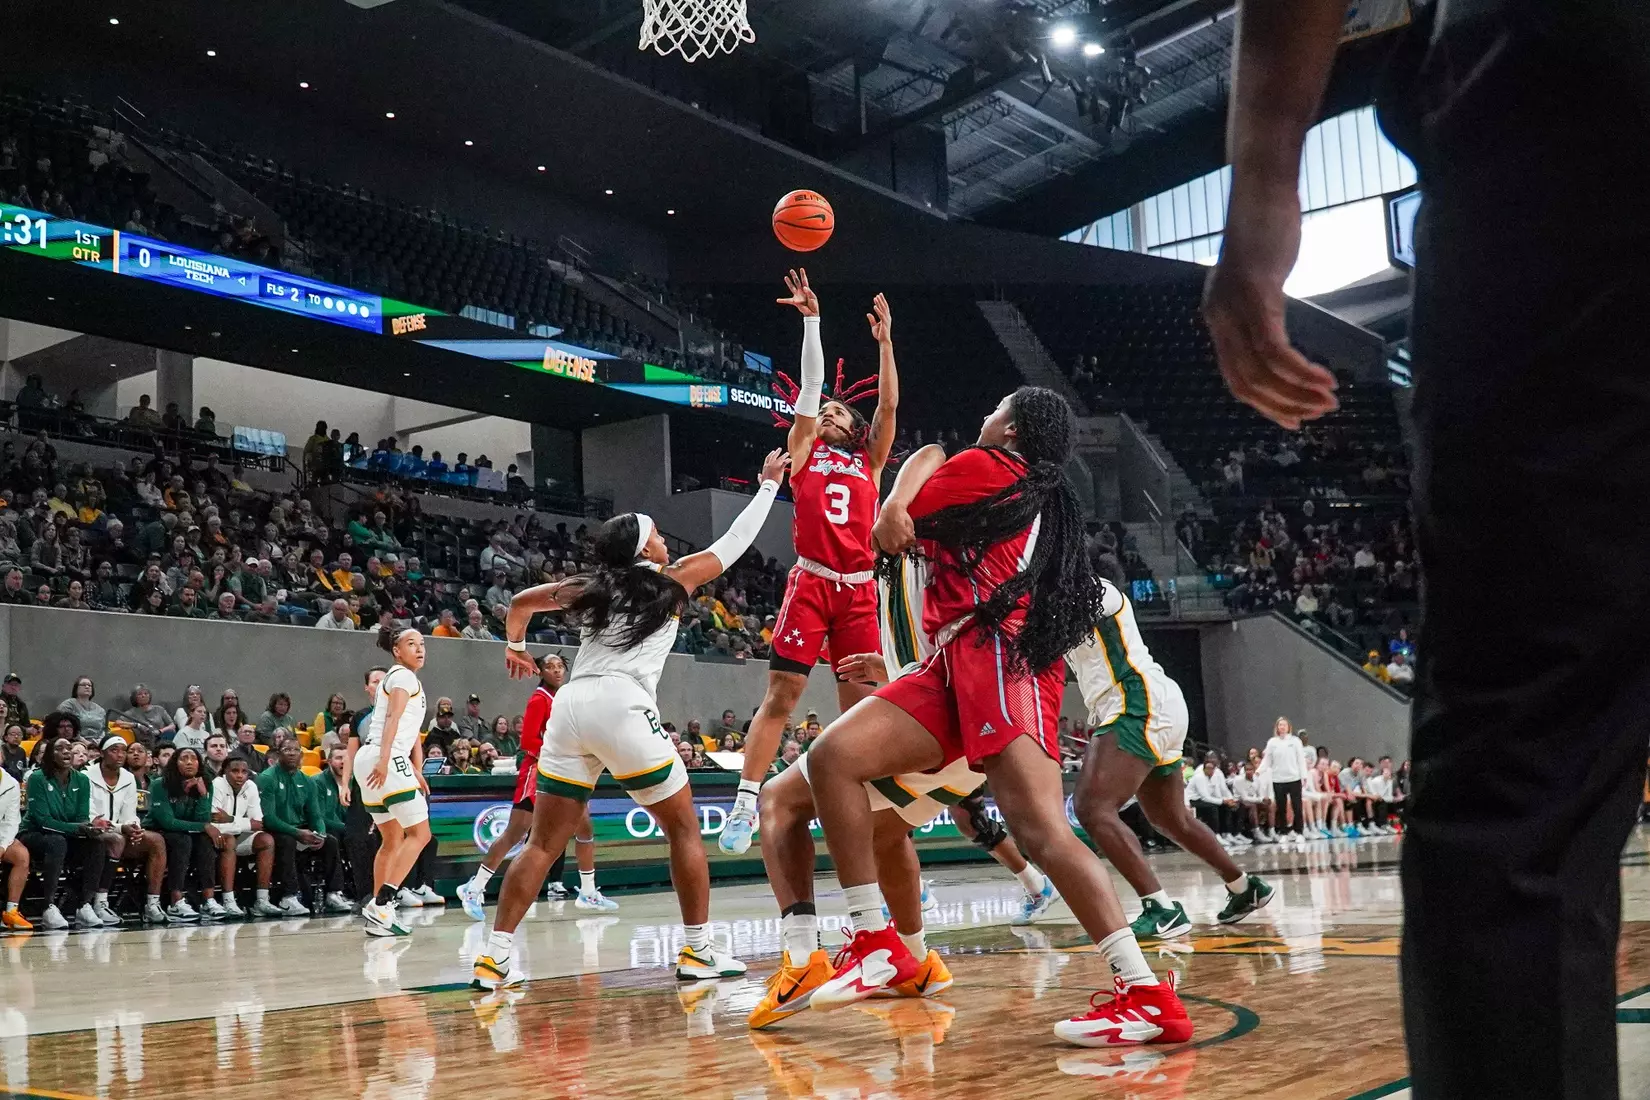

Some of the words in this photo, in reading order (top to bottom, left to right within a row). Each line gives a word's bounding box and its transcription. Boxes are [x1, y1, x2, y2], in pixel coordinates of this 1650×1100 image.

[0, 208, 47, 249] :31
[74, 229, 100, 247] 1ST
[72, 246, 101, 263] QTR
[139, 248, 151, 268] 0
[169, 254, 231, 279] LOUISIANA
[184, 269, 214, 285] TECH
[266, 282, 285, 297] FLS
[290, 287, 299, 303] 2
[308, 293, 321, 306] TO
[391, 313, 427, 336] DEFENSE
[542, 346, 598, 384] DEFENSE
[690, 384, 722, 403] DEFENSE
[730, 387, 773, 410] SECOND
[773, 398, 796, 416] TEA
[825, 482, 851, 525] 3
